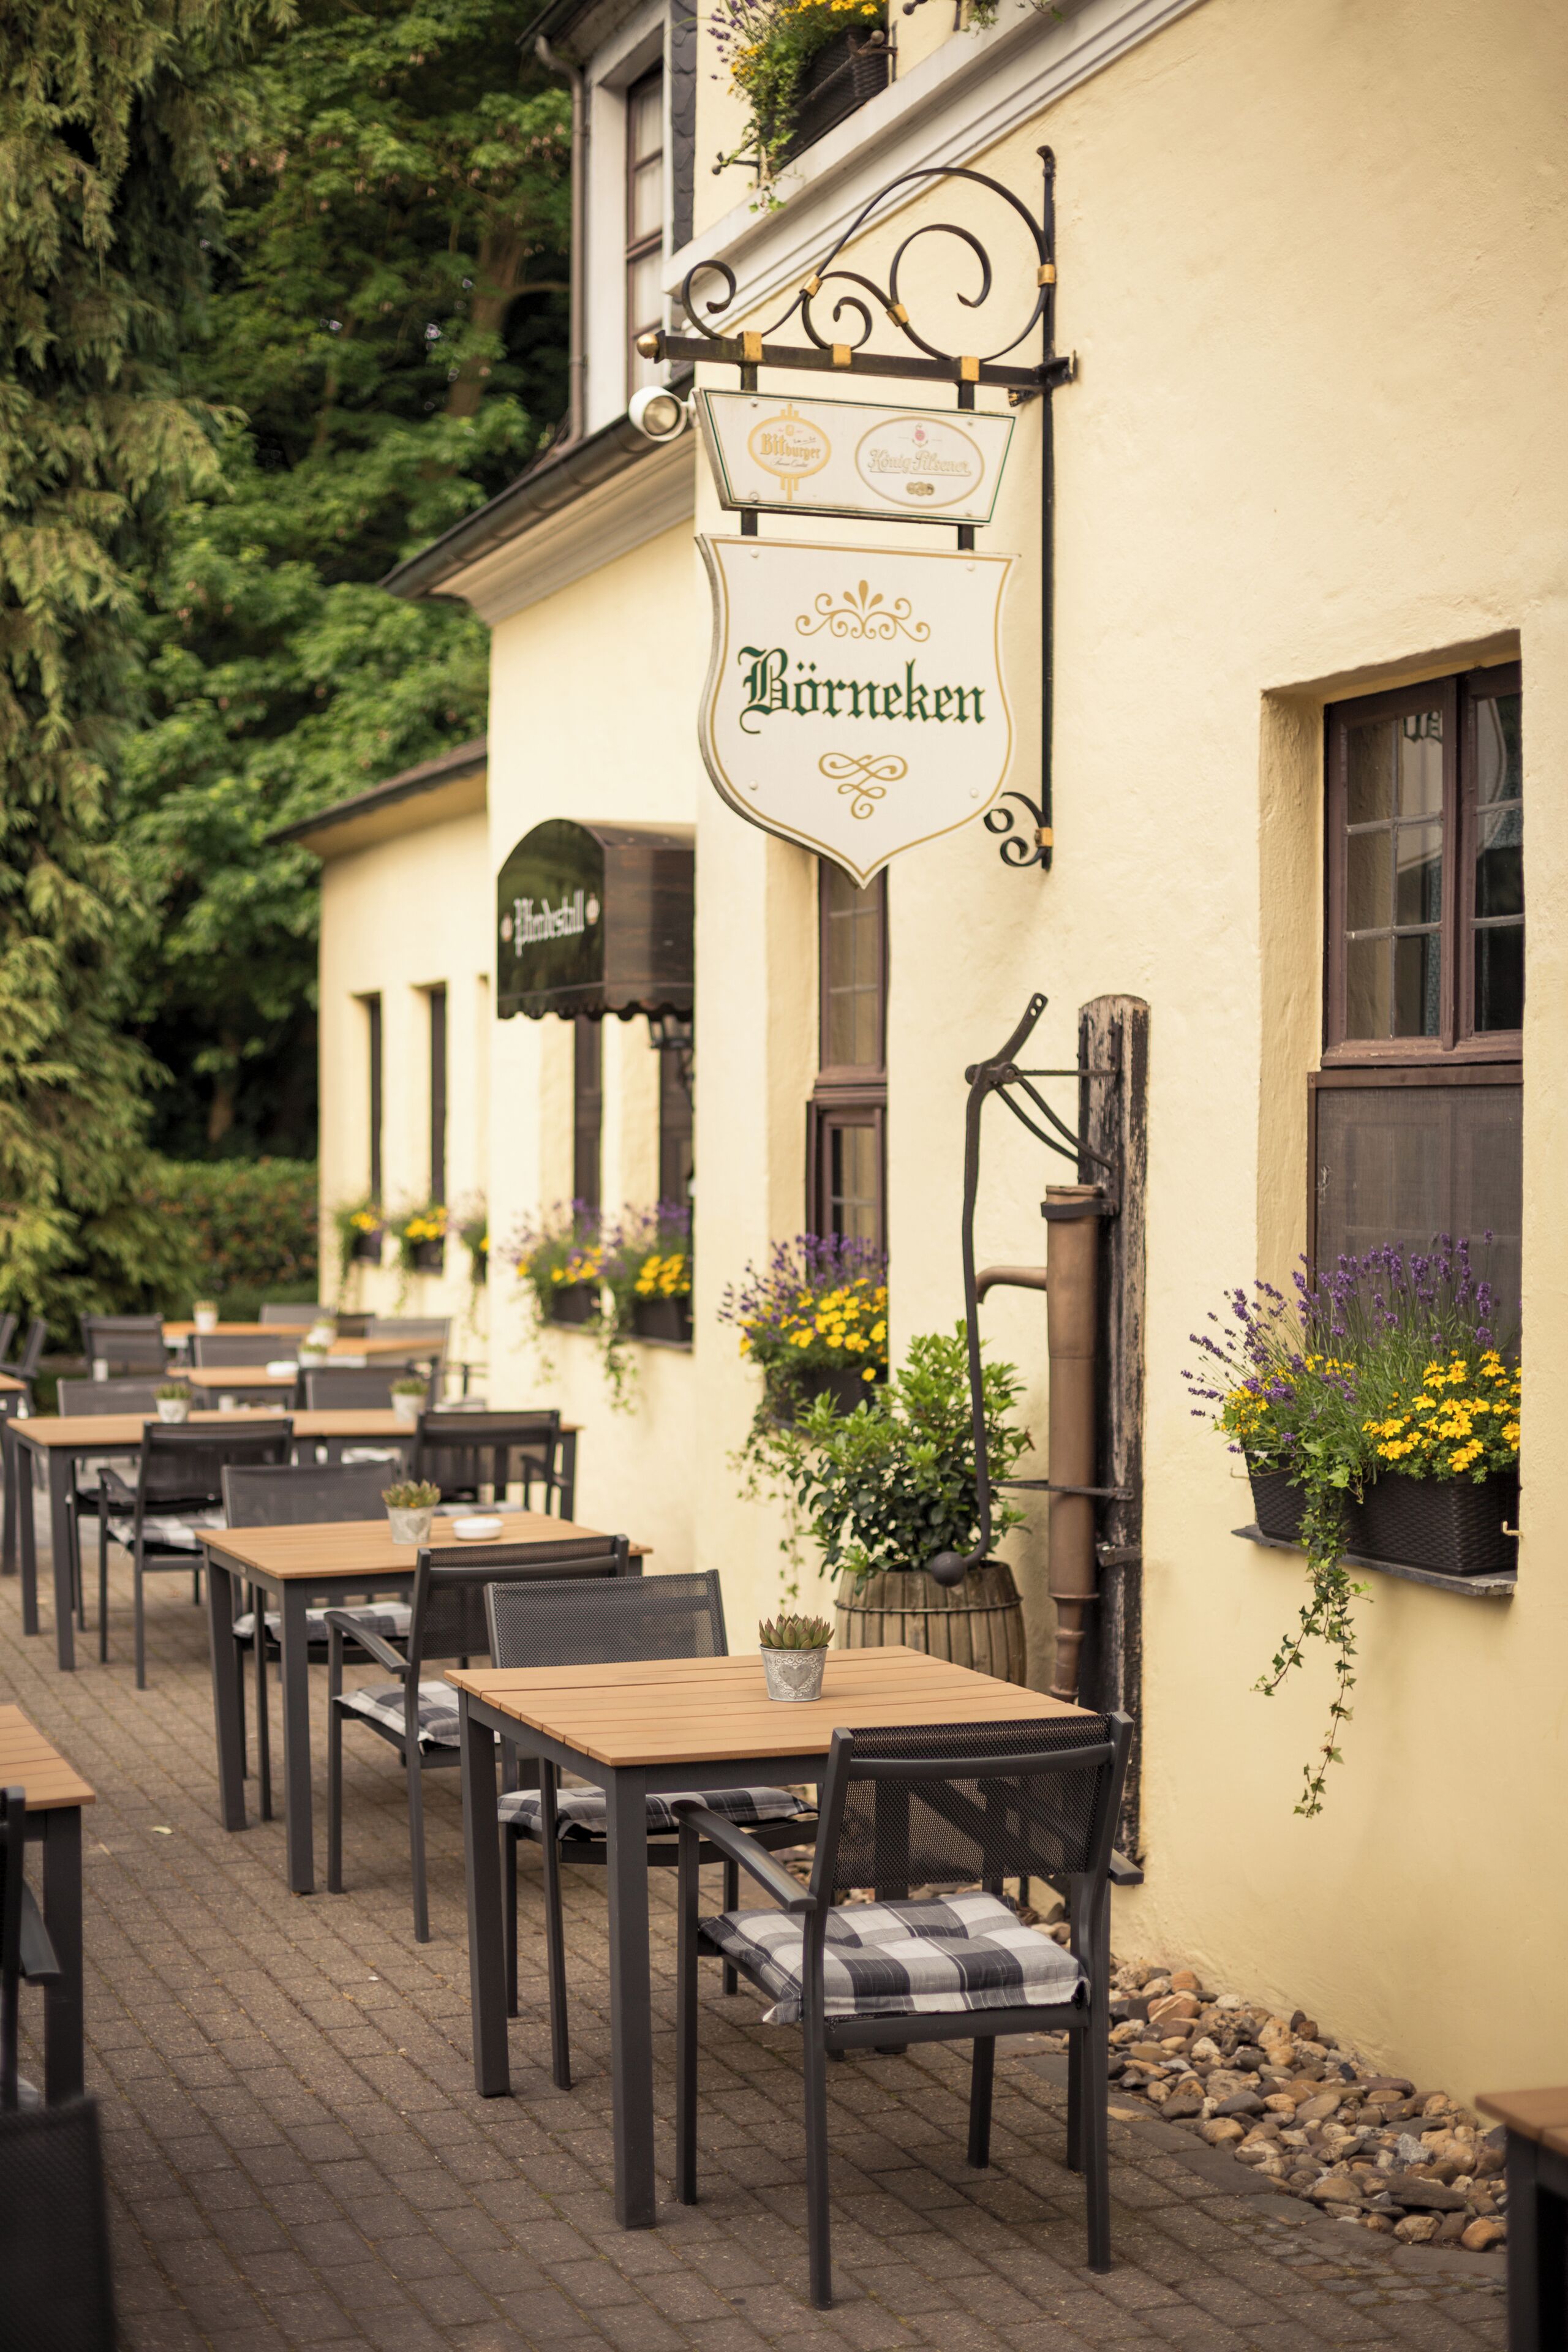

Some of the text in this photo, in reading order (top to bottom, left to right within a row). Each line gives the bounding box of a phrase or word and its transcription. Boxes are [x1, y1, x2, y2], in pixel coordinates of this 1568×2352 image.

[760, 432, 821, 461] Bitburger
[867, 448, 971, 475] König-Pilsener
[737, 646, 986, 734] Börneken
